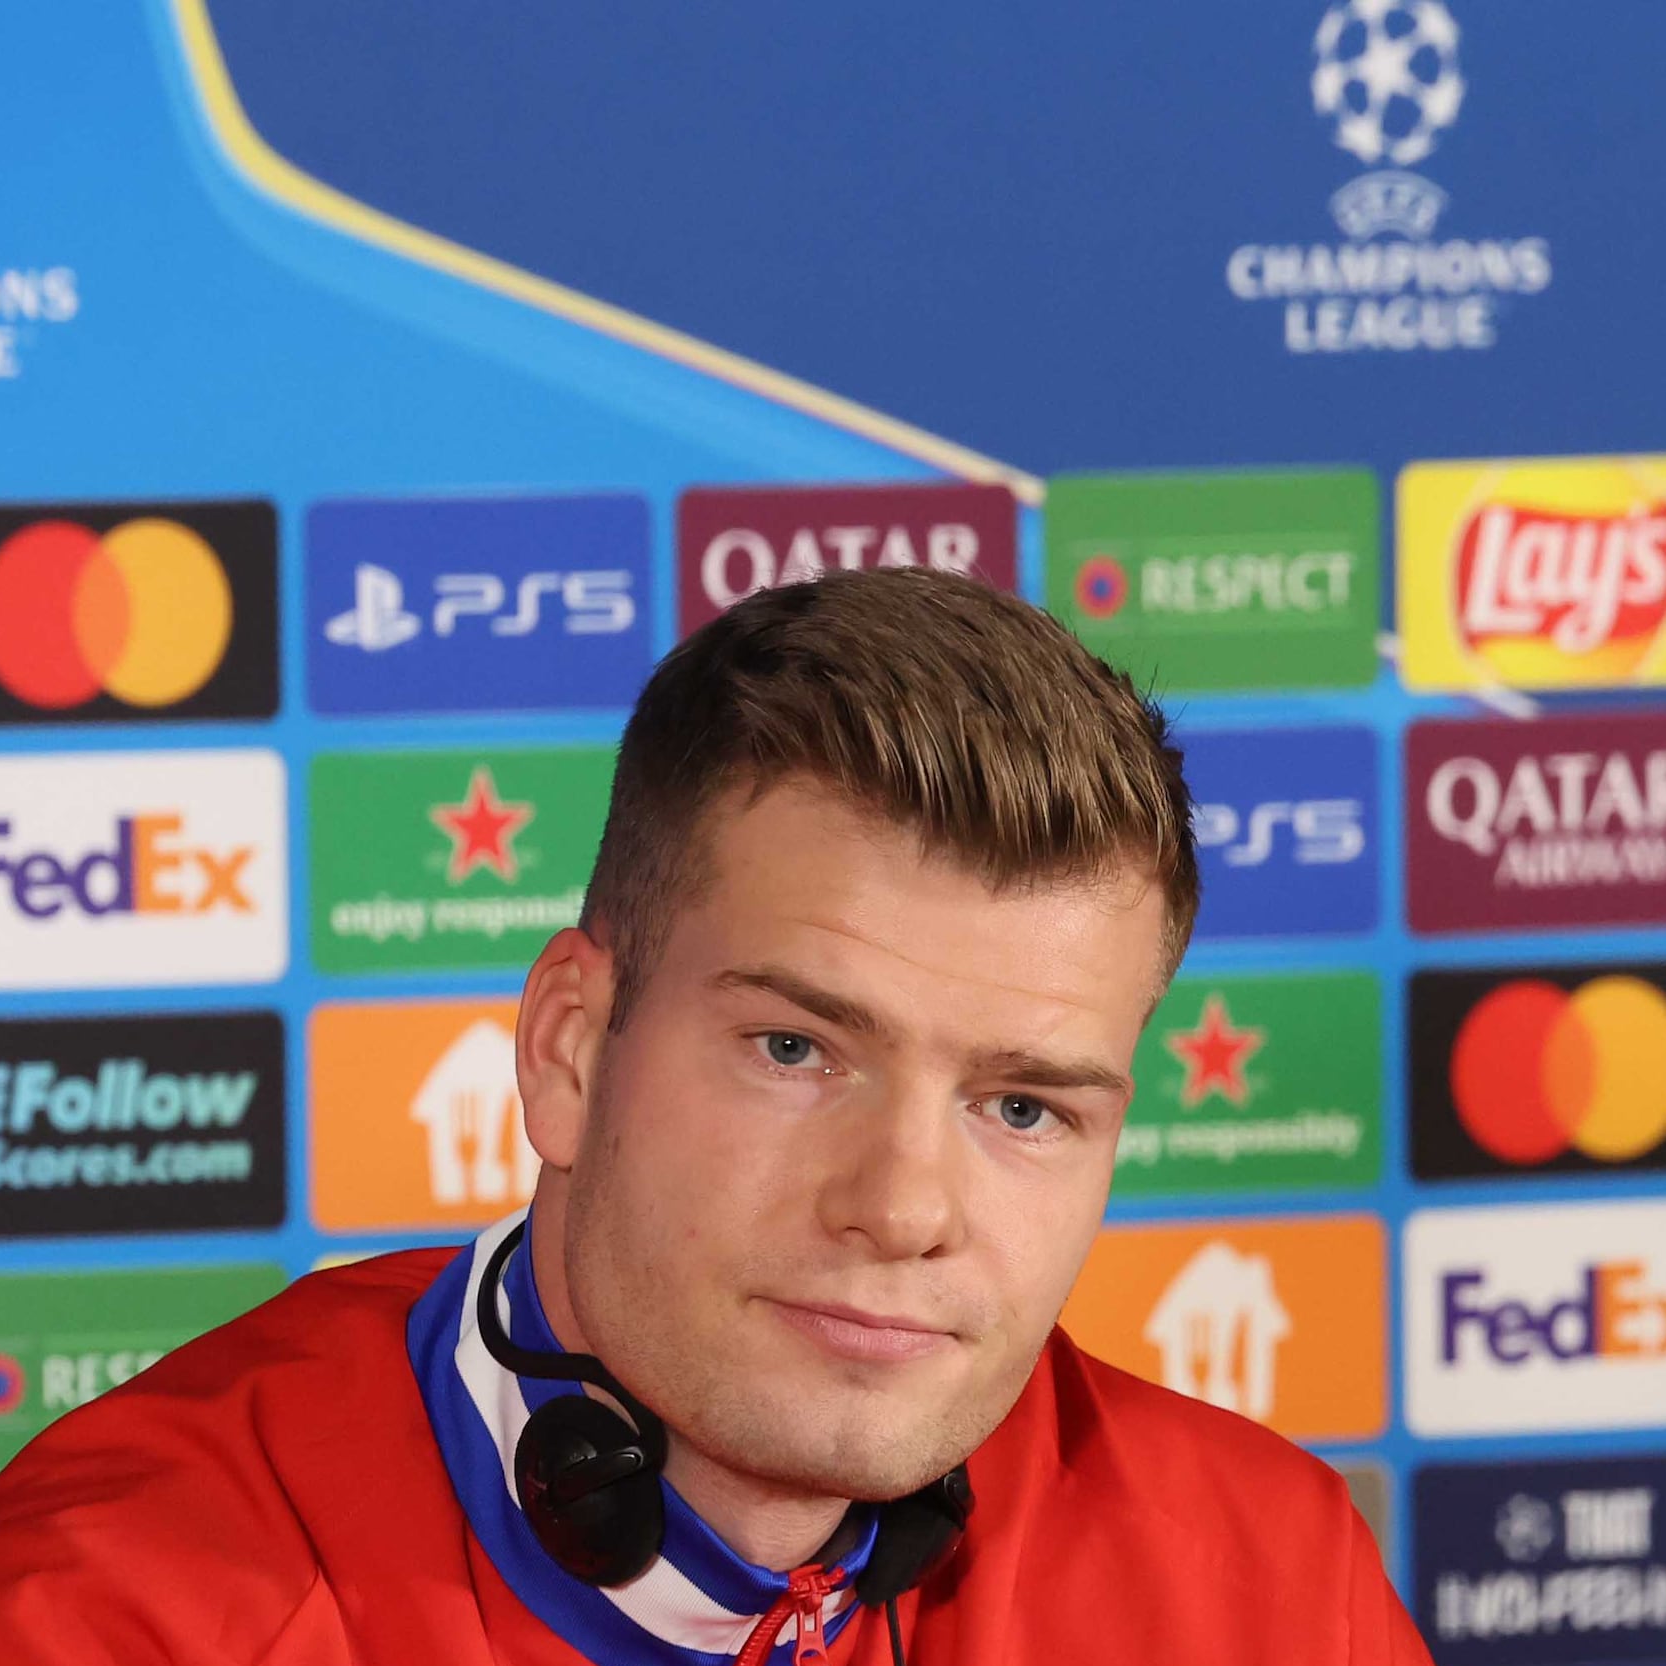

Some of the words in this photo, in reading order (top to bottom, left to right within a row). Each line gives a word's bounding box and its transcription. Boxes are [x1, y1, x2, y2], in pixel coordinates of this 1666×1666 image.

[1227, 237, 1552, 300] CHAMPIONS
[1284, 295, 1497, 353] LEAGUE
[432, 569, 636, 638] PS5
[1141, 551, 1356, 614] RESPECT
